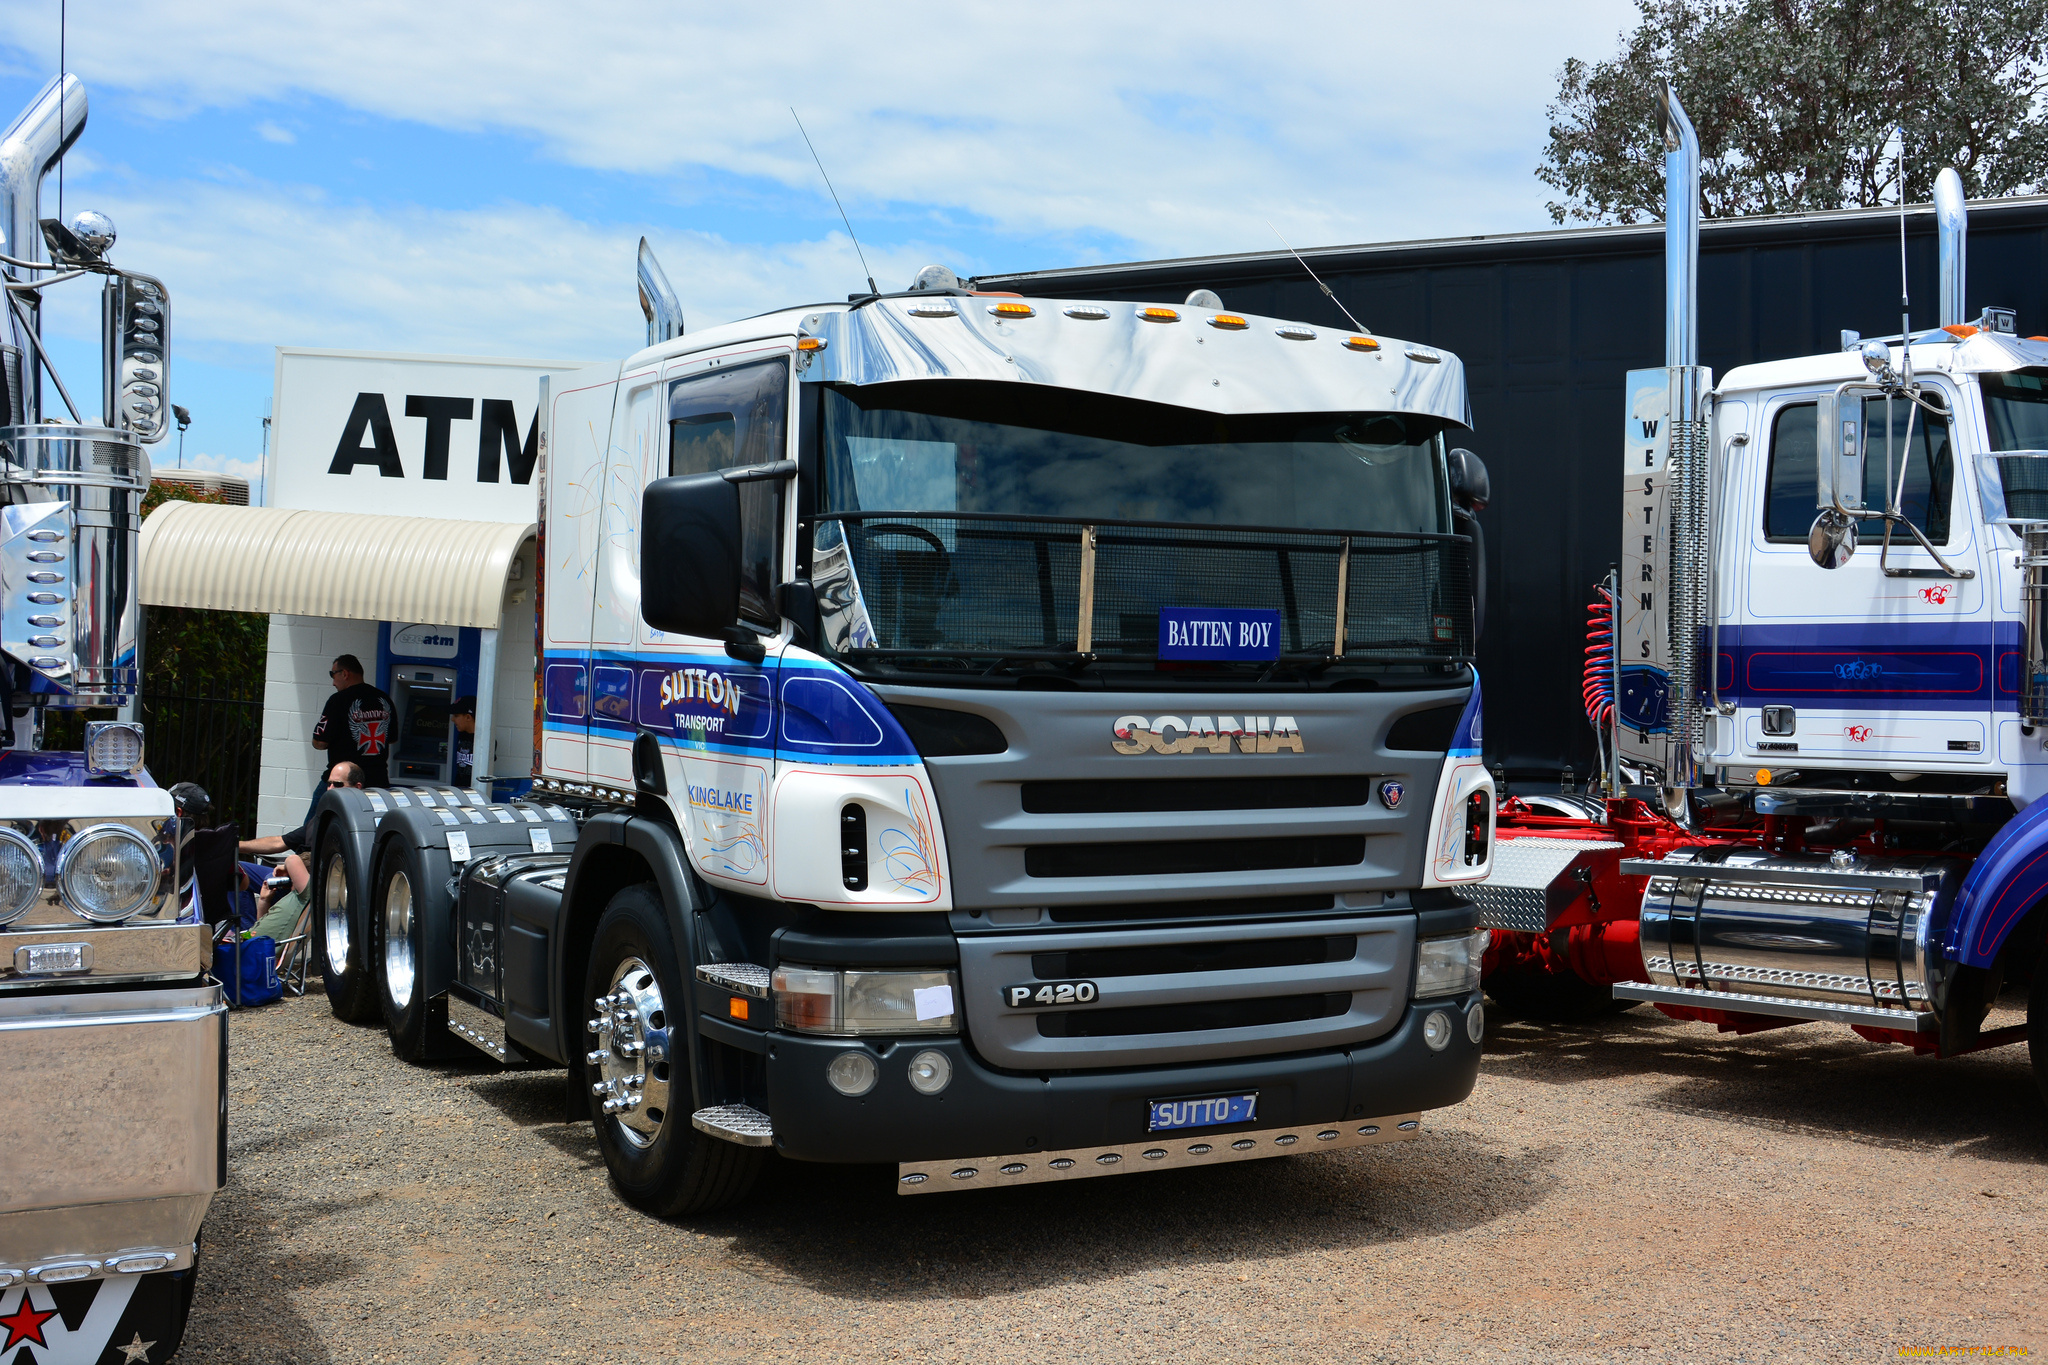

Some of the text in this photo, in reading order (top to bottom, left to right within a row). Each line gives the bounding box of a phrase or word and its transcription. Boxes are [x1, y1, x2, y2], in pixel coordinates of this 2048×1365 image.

[327, 392, 539, 485] ATM
[1640, 420, 1659, 611] WESTERN
[1167, 620, 1272, 648] BATTEN BOY
[660, 668, 741, 717] SUTTON
[675, 713, 725, 733] TRANSPORT
[1111, 715, 1305, 754] SCANIA
[694, 741, 706, 750] VIC
[688, 785, 753, 814] KINGLAKE
[1011, 982, 1095, 1007] P 420
